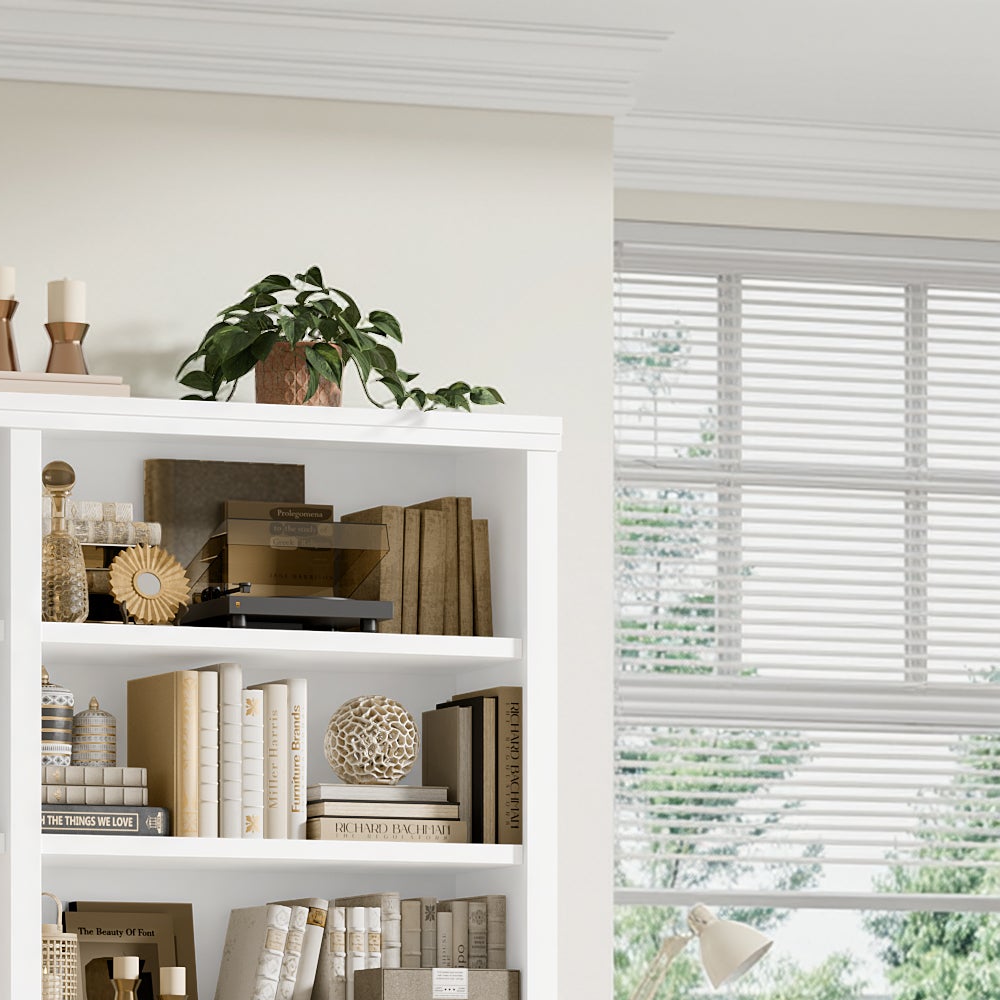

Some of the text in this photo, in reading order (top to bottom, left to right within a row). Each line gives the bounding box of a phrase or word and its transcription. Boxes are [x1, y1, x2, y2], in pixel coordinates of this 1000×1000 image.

[277, 509, 323, 519] Prolegomena
[268, 709, 278, 809] Miller Harris
[291, 705, 301, 813] Furniture Brands
[510, 702, 520, 829] RICHARD BACHMAN
[47, 815, 63, 826] THE
[65, 815, 96, 826] THINGS
[97, 816, 111, 827] WE
[112, 816, 134, 827] LOVE
[335, 822, 451, 836] RICHARD BACHMAN
[78, 927, 155, 938] The Beauty Of Font
